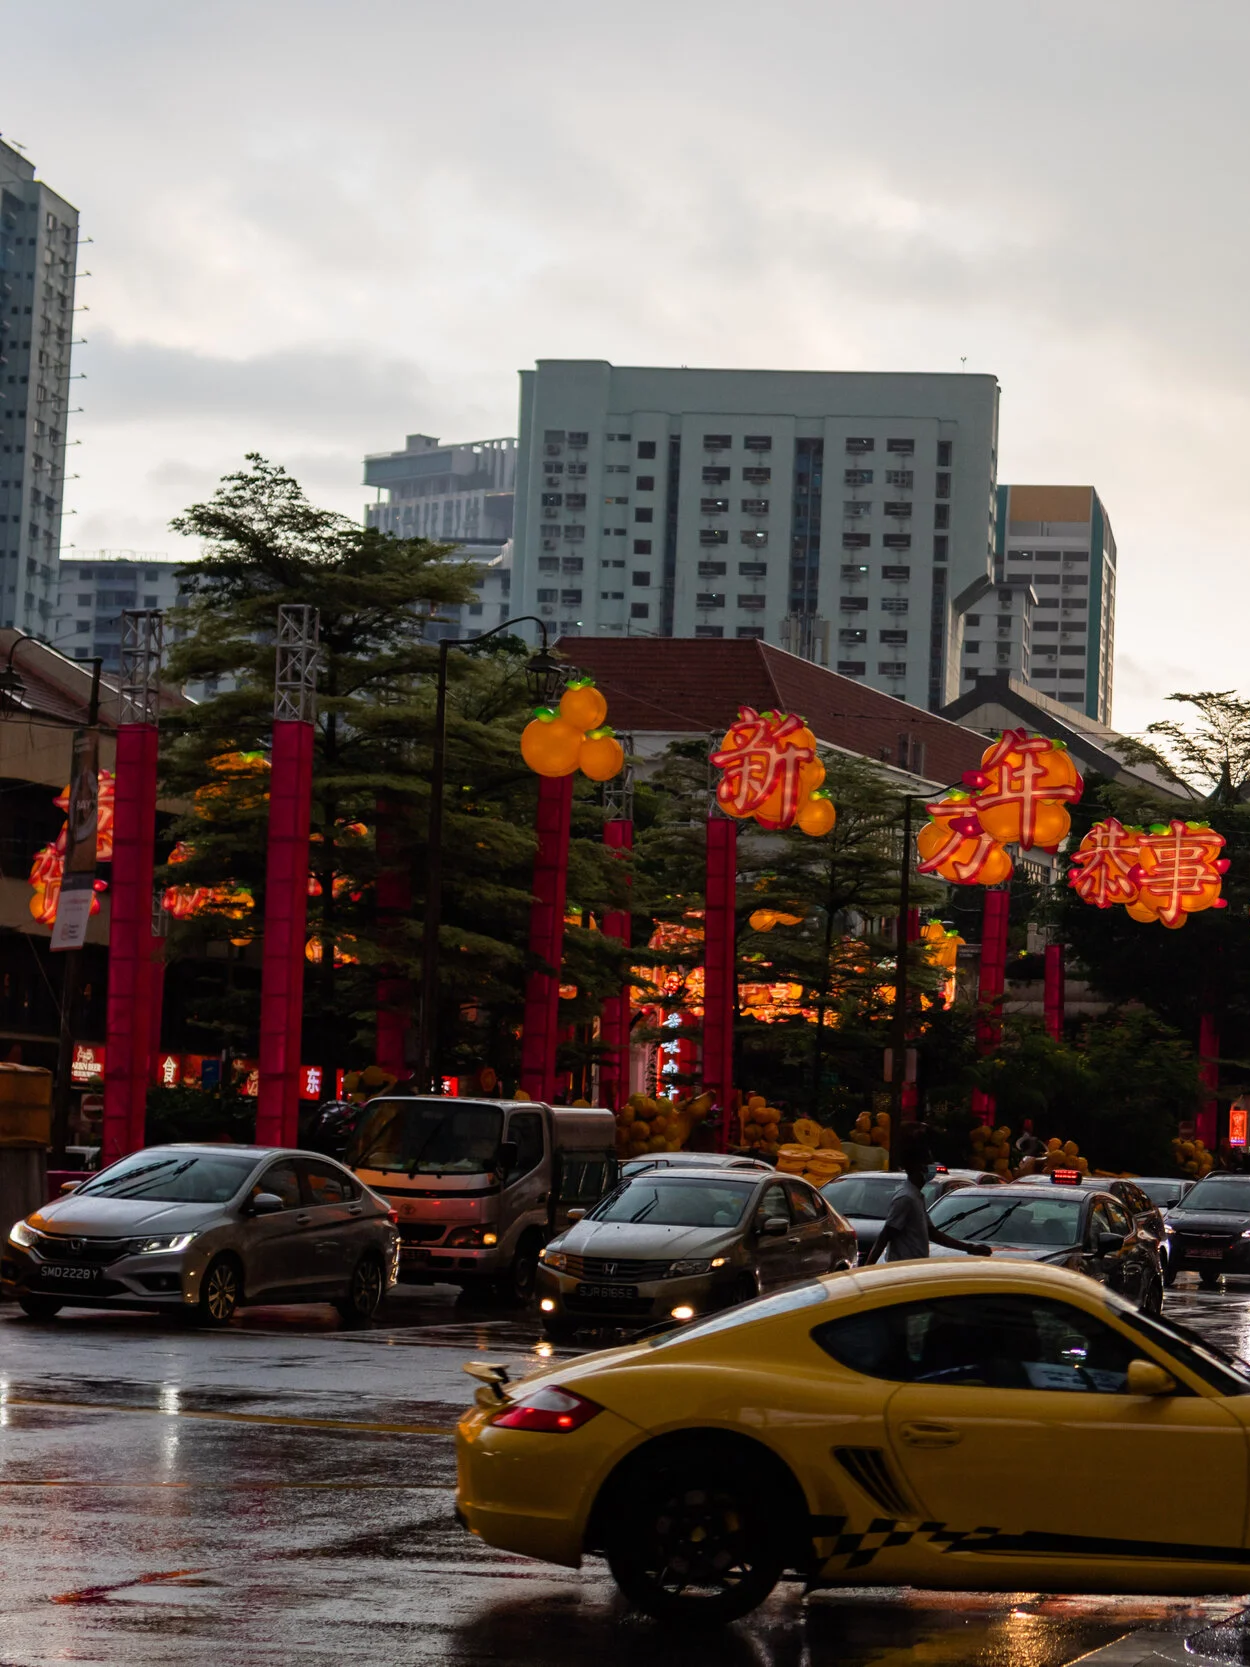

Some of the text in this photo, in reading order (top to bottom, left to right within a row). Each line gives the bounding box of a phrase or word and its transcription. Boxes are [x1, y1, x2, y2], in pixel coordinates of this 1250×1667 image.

[709, 706, 814, 829] 新
[970, 728, 1083, 851] 年
[1068, 816, 1142, 908] 恭
[1137, 819, 1226, 926] 事
[306, 1067, 322, 1094] 东
